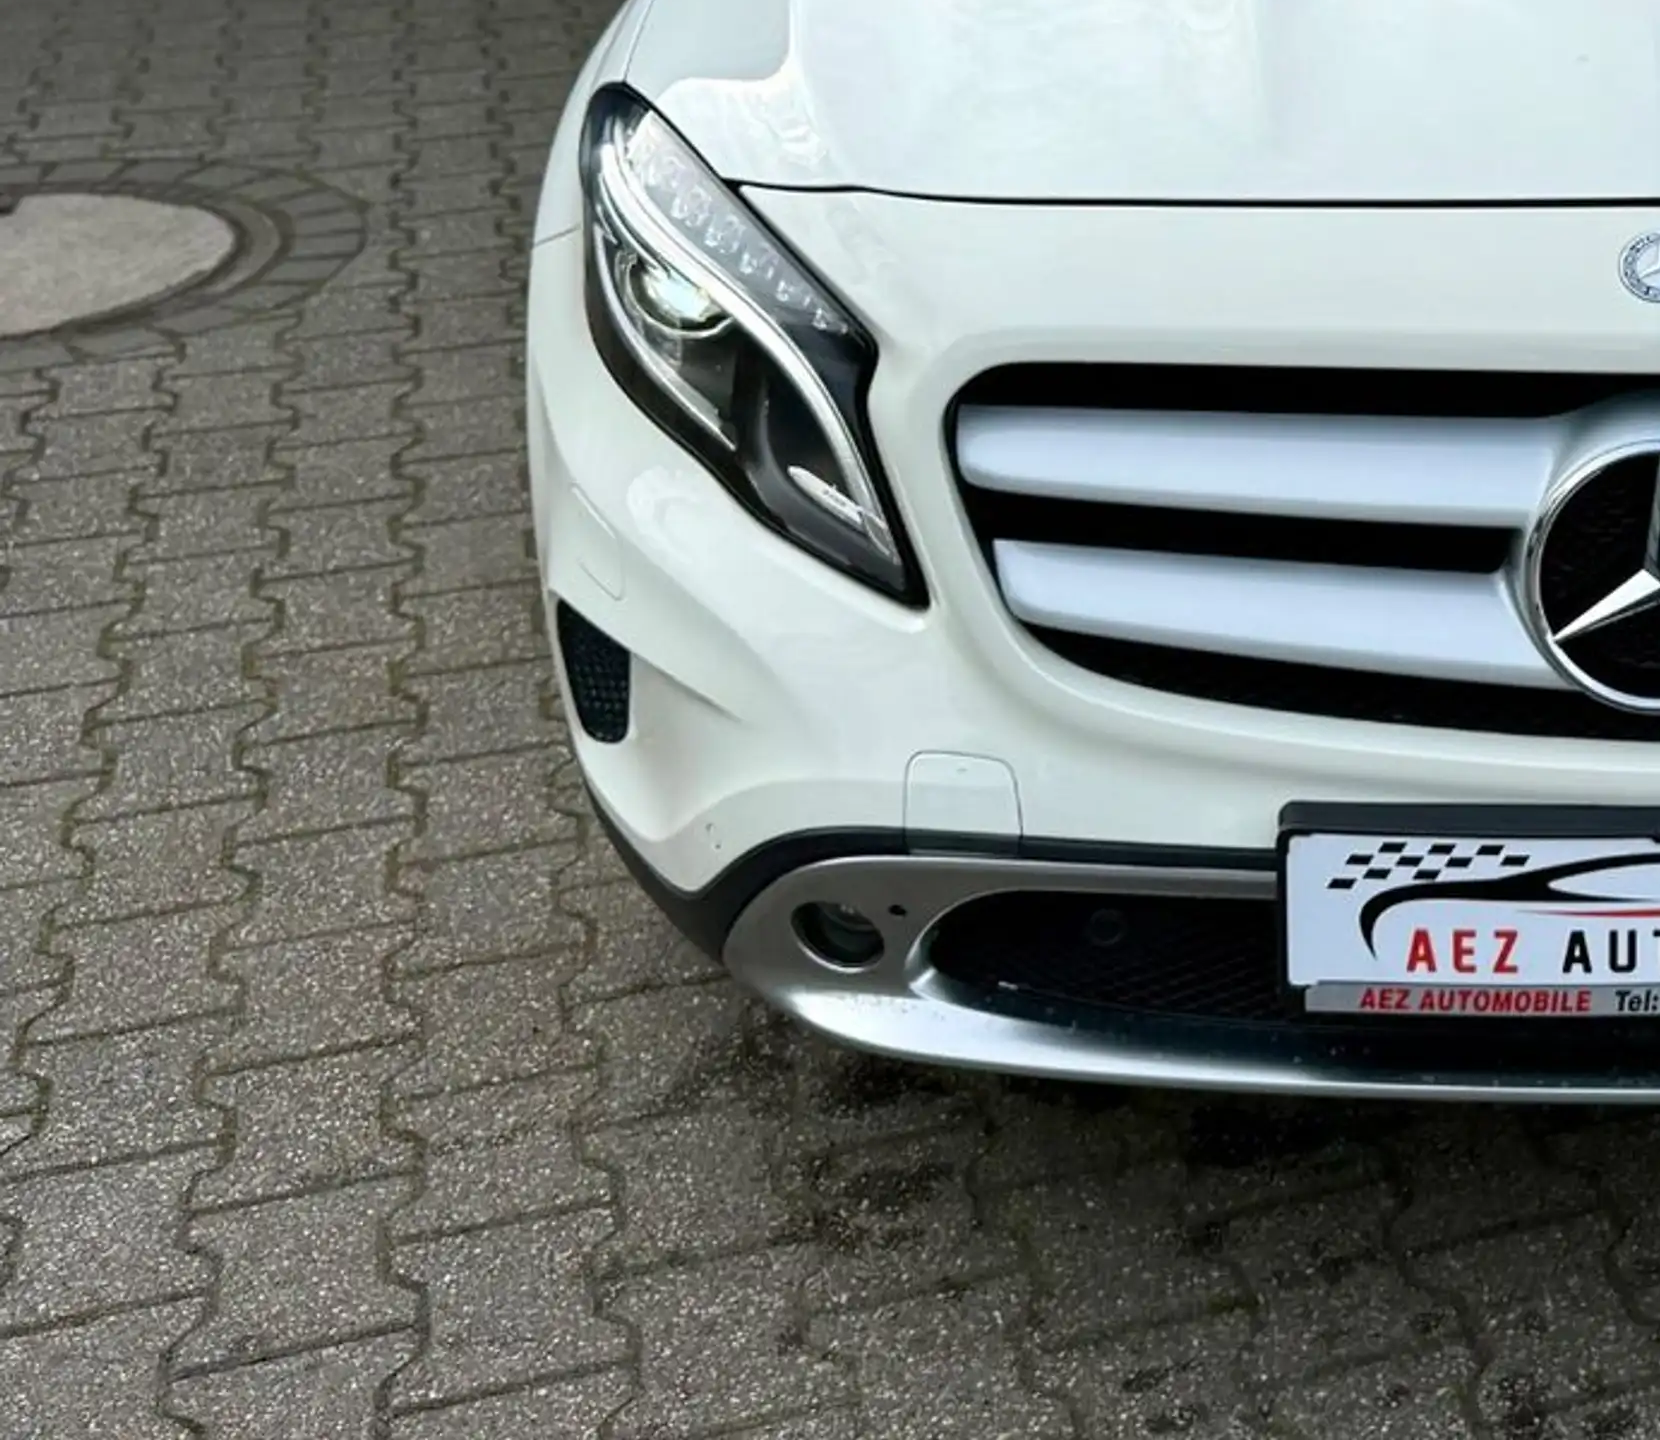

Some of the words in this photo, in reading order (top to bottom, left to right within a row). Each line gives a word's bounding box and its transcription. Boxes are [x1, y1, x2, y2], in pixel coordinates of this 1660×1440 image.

[1406, 927, 1520, 974] AEZ
[1359, 986, 1411, 1010] AEZ
[1419, 989, 1592, 1013] AUTOMOBILE
[1614, 990, 1659, 1012] Tel:
